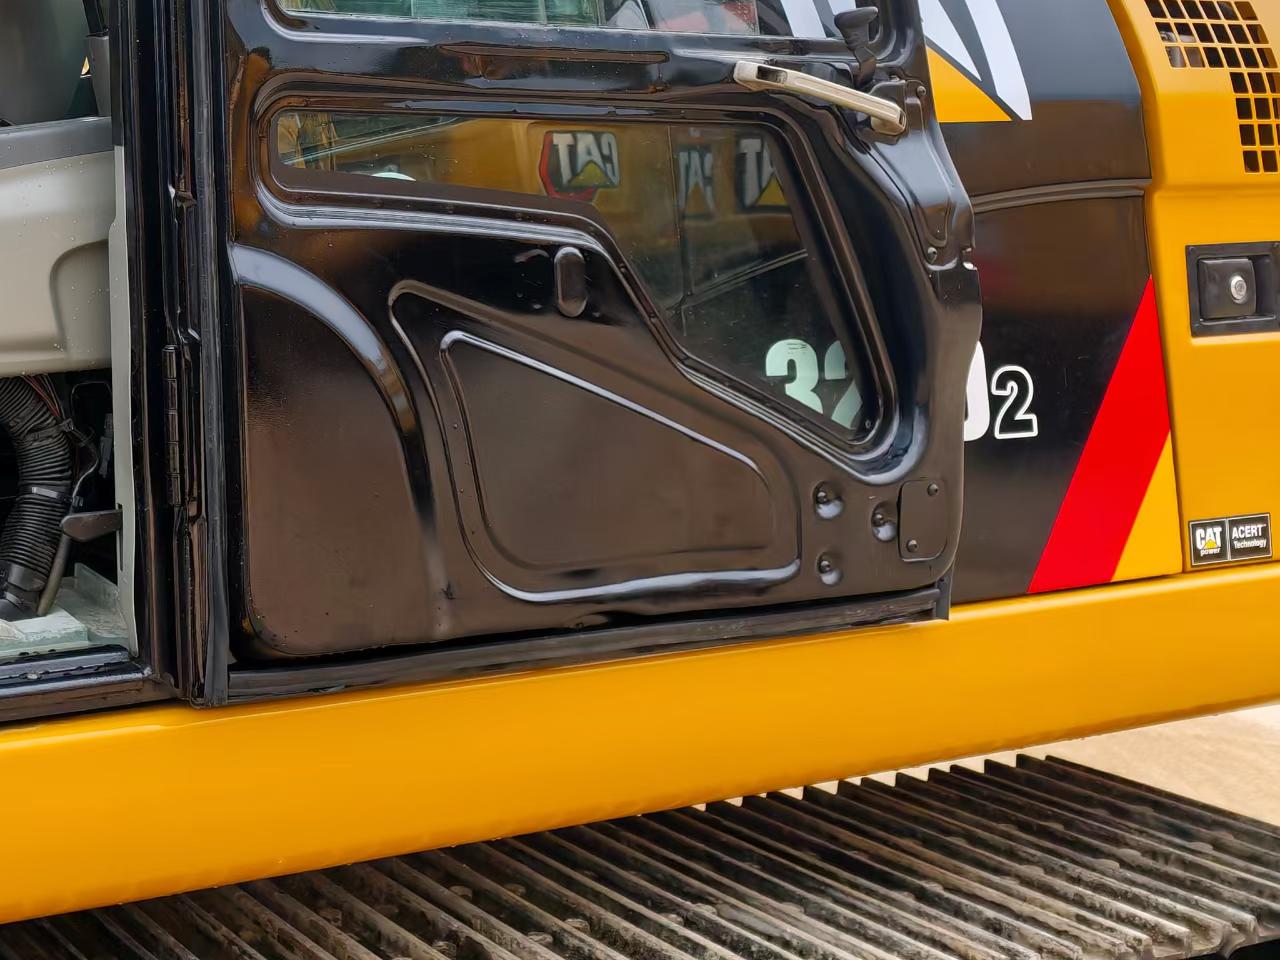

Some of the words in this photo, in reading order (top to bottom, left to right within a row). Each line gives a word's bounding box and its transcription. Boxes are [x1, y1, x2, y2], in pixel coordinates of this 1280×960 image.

[1195, 527, 1222, 549] CAT
[1232, 525, 1263, 539] ACERT
[1233, 539, 1266, 549] Technology
